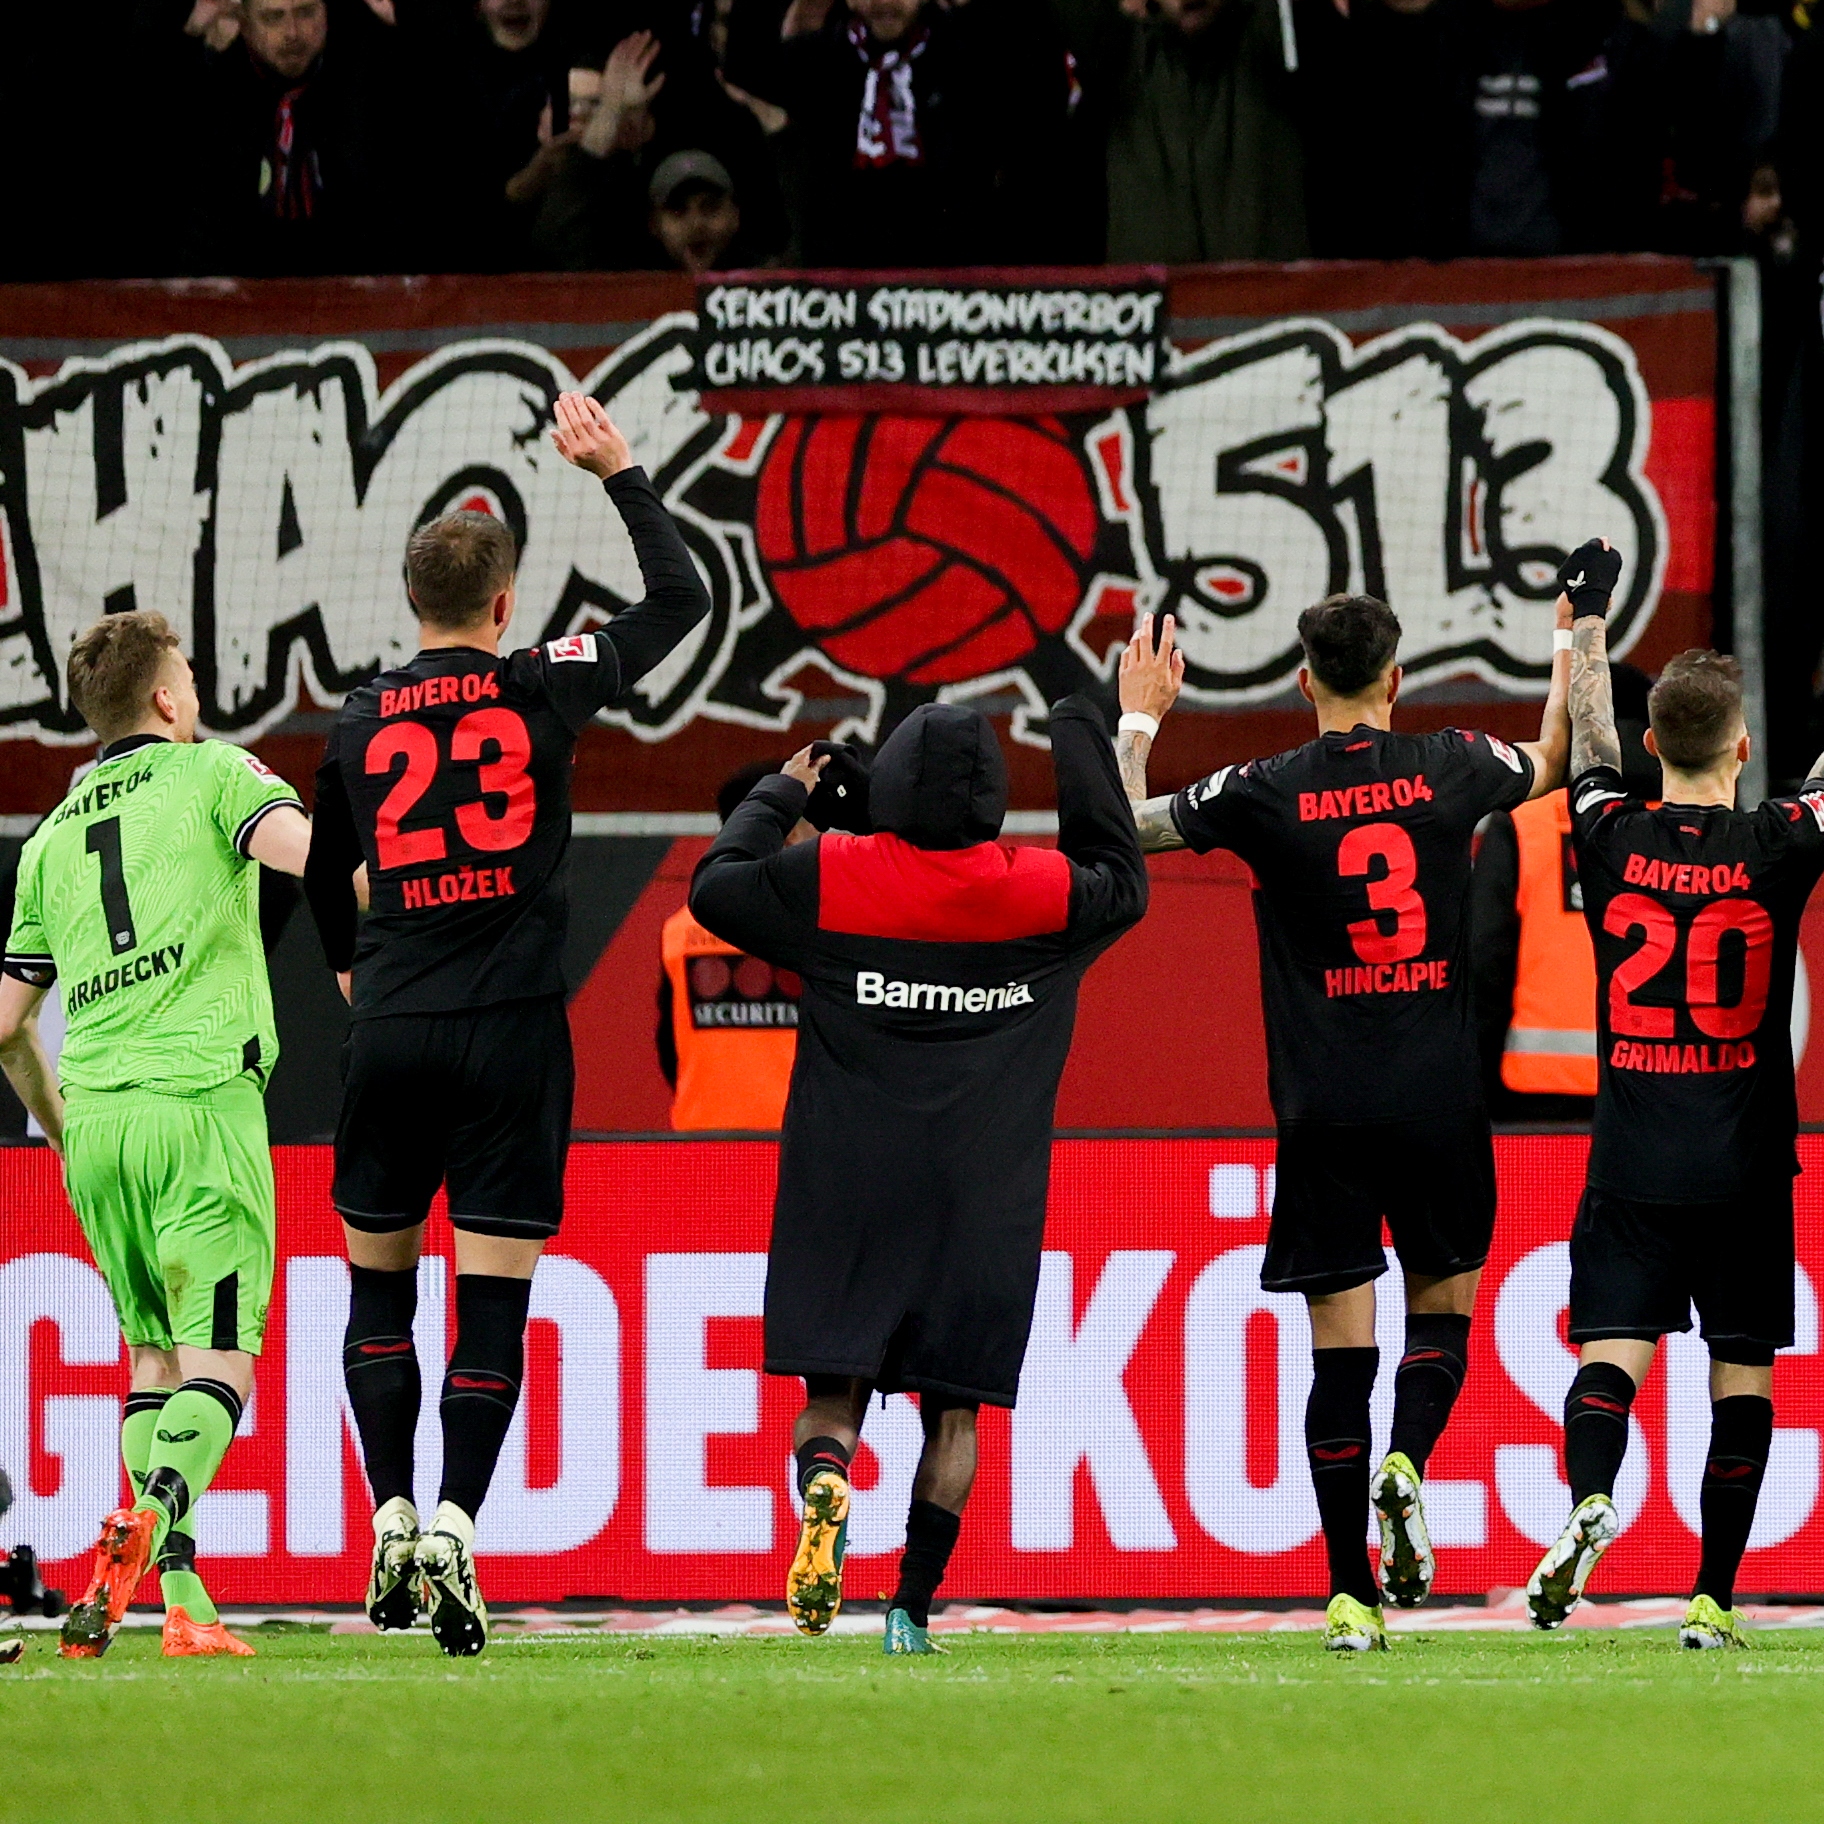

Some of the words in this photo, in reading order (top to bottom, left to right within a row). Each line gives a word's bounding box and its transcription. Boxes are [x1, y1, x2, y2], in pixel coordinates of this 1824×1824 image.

[705, 283, 859, 329] SEKTION
[867, 287, 1164, 336] STADIONVERBOT
[705, 340, 824, 386] CHAOS
[837, 338, 906, 382] 513
[916, 338, 1156, 387] LEVERKUSEN
[0, 314, 724, 746] HAOS
[1136, 319, 1664, 696] 513
[365, 707, 536, 870] 23
[86, 815, 137, 956] 1
[402, 864, 515, 909] HLOŽEK
[1337, 822, 1427, 965] 3
[68, 942, 185, 1017] HRADECKY
[857, 971, 1032, 1014] Barmenia
[1325, 960, 1450, 999] HINCAPIE
[1604, 892, 1773, 1039] 20
[1610, 1038, 1756, 1074] GRIMALDO
